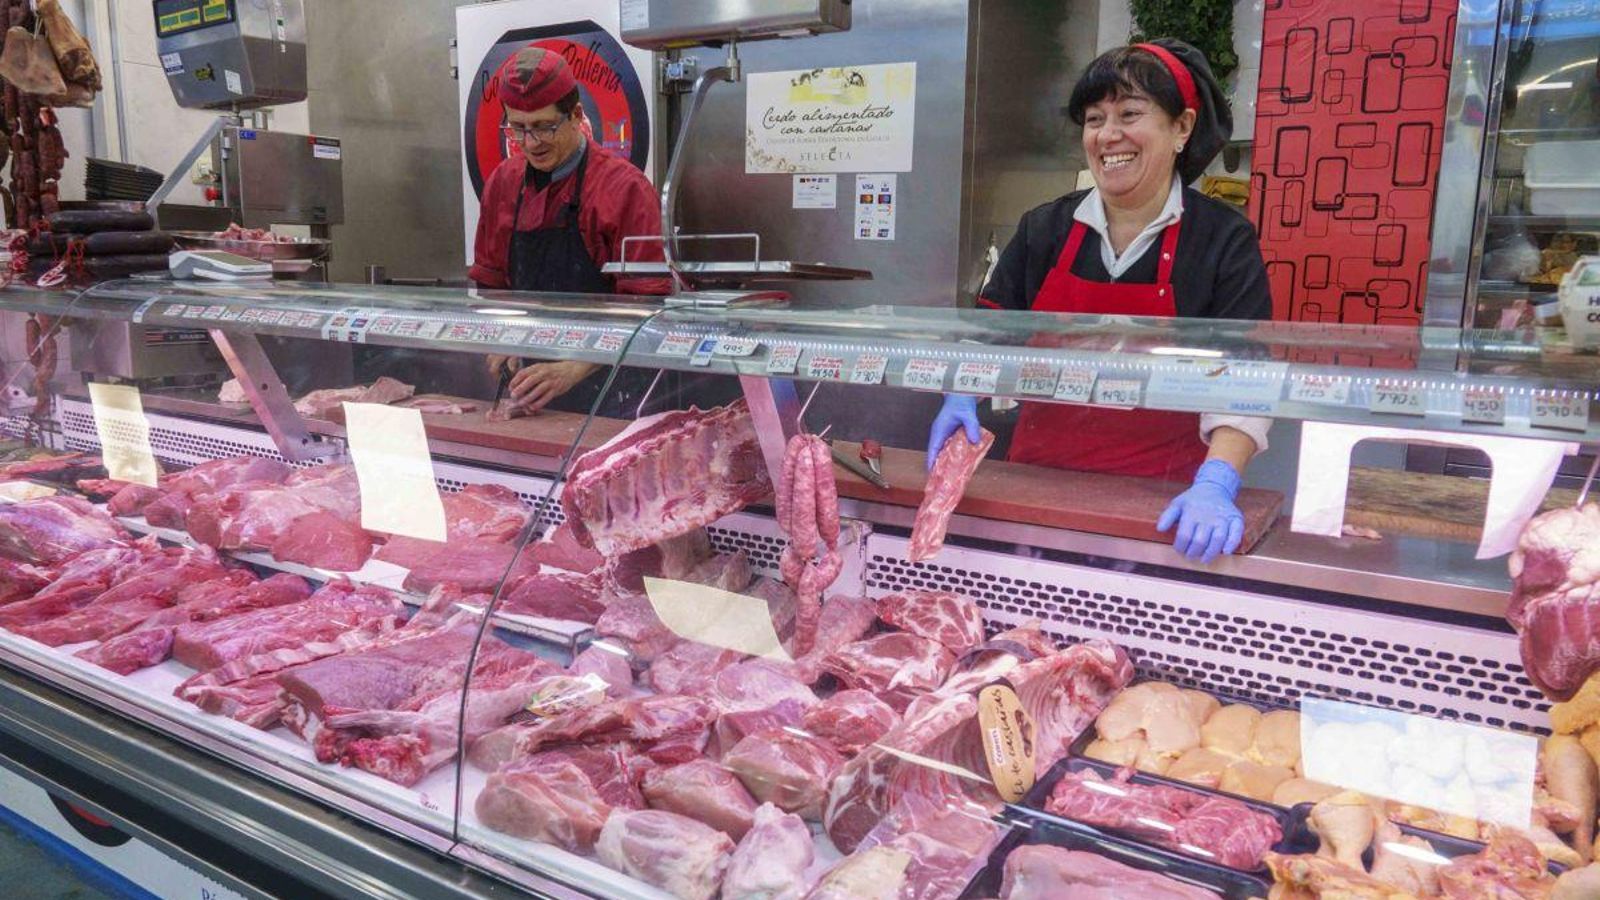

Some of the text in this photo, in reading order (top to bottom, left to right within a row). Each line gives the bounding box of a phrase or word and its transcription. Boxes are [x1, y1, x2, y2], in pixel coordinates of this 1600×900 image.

[762, 103, 894, 129] Cerdo alimentado
[781, 125, 805, 135] con
[800, 148, 852, 161] SELECTA
